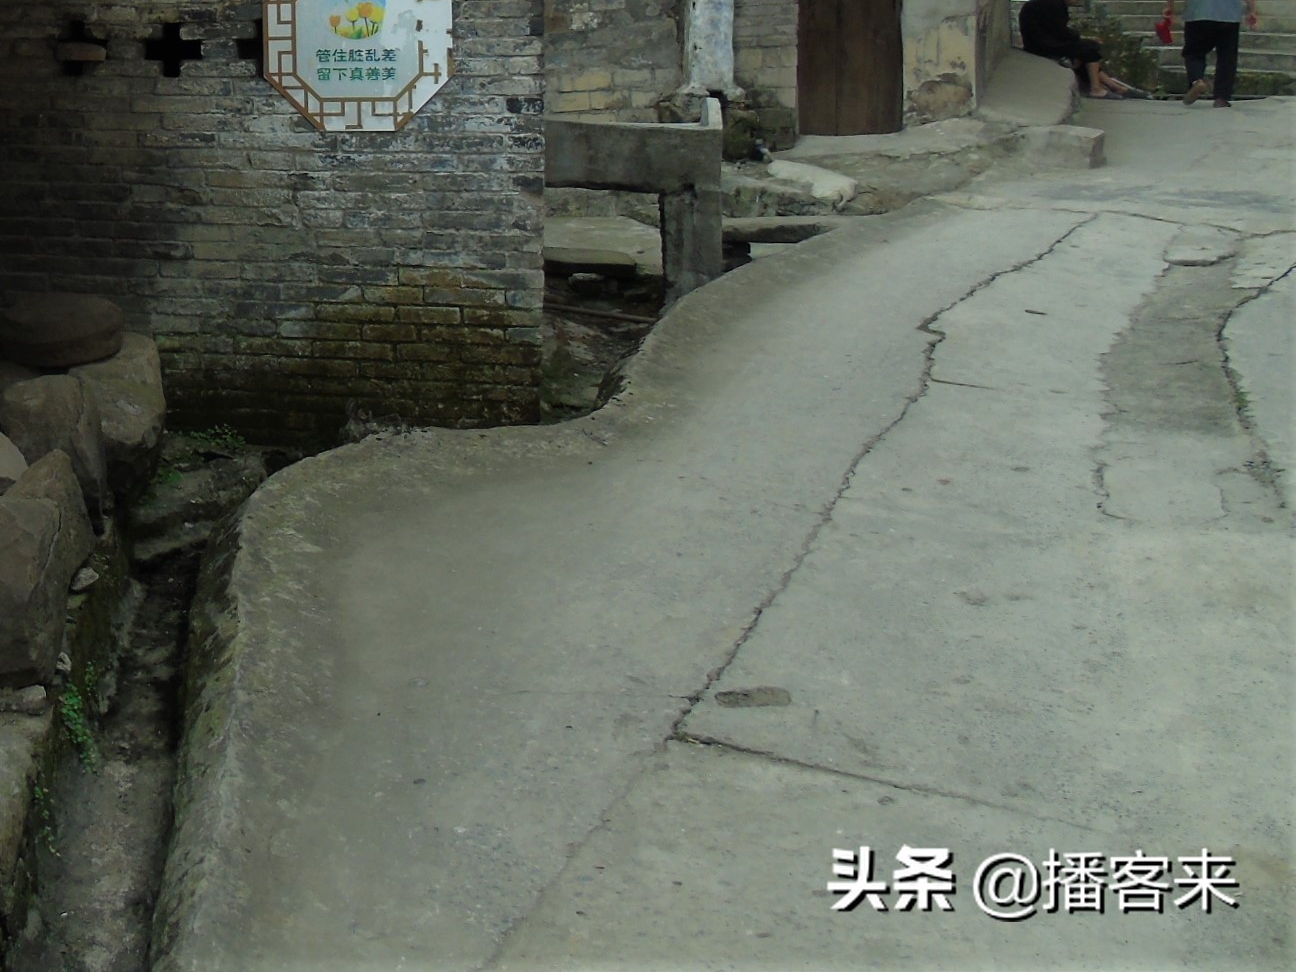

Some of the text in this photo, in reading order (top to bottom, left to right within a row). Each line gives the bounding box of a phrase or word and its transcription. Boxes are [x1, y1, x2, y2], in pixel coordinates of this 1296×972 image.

[315, 48, 397, 63] 管住脏乱差
[316, 66, 396, 81] 留下真善美
